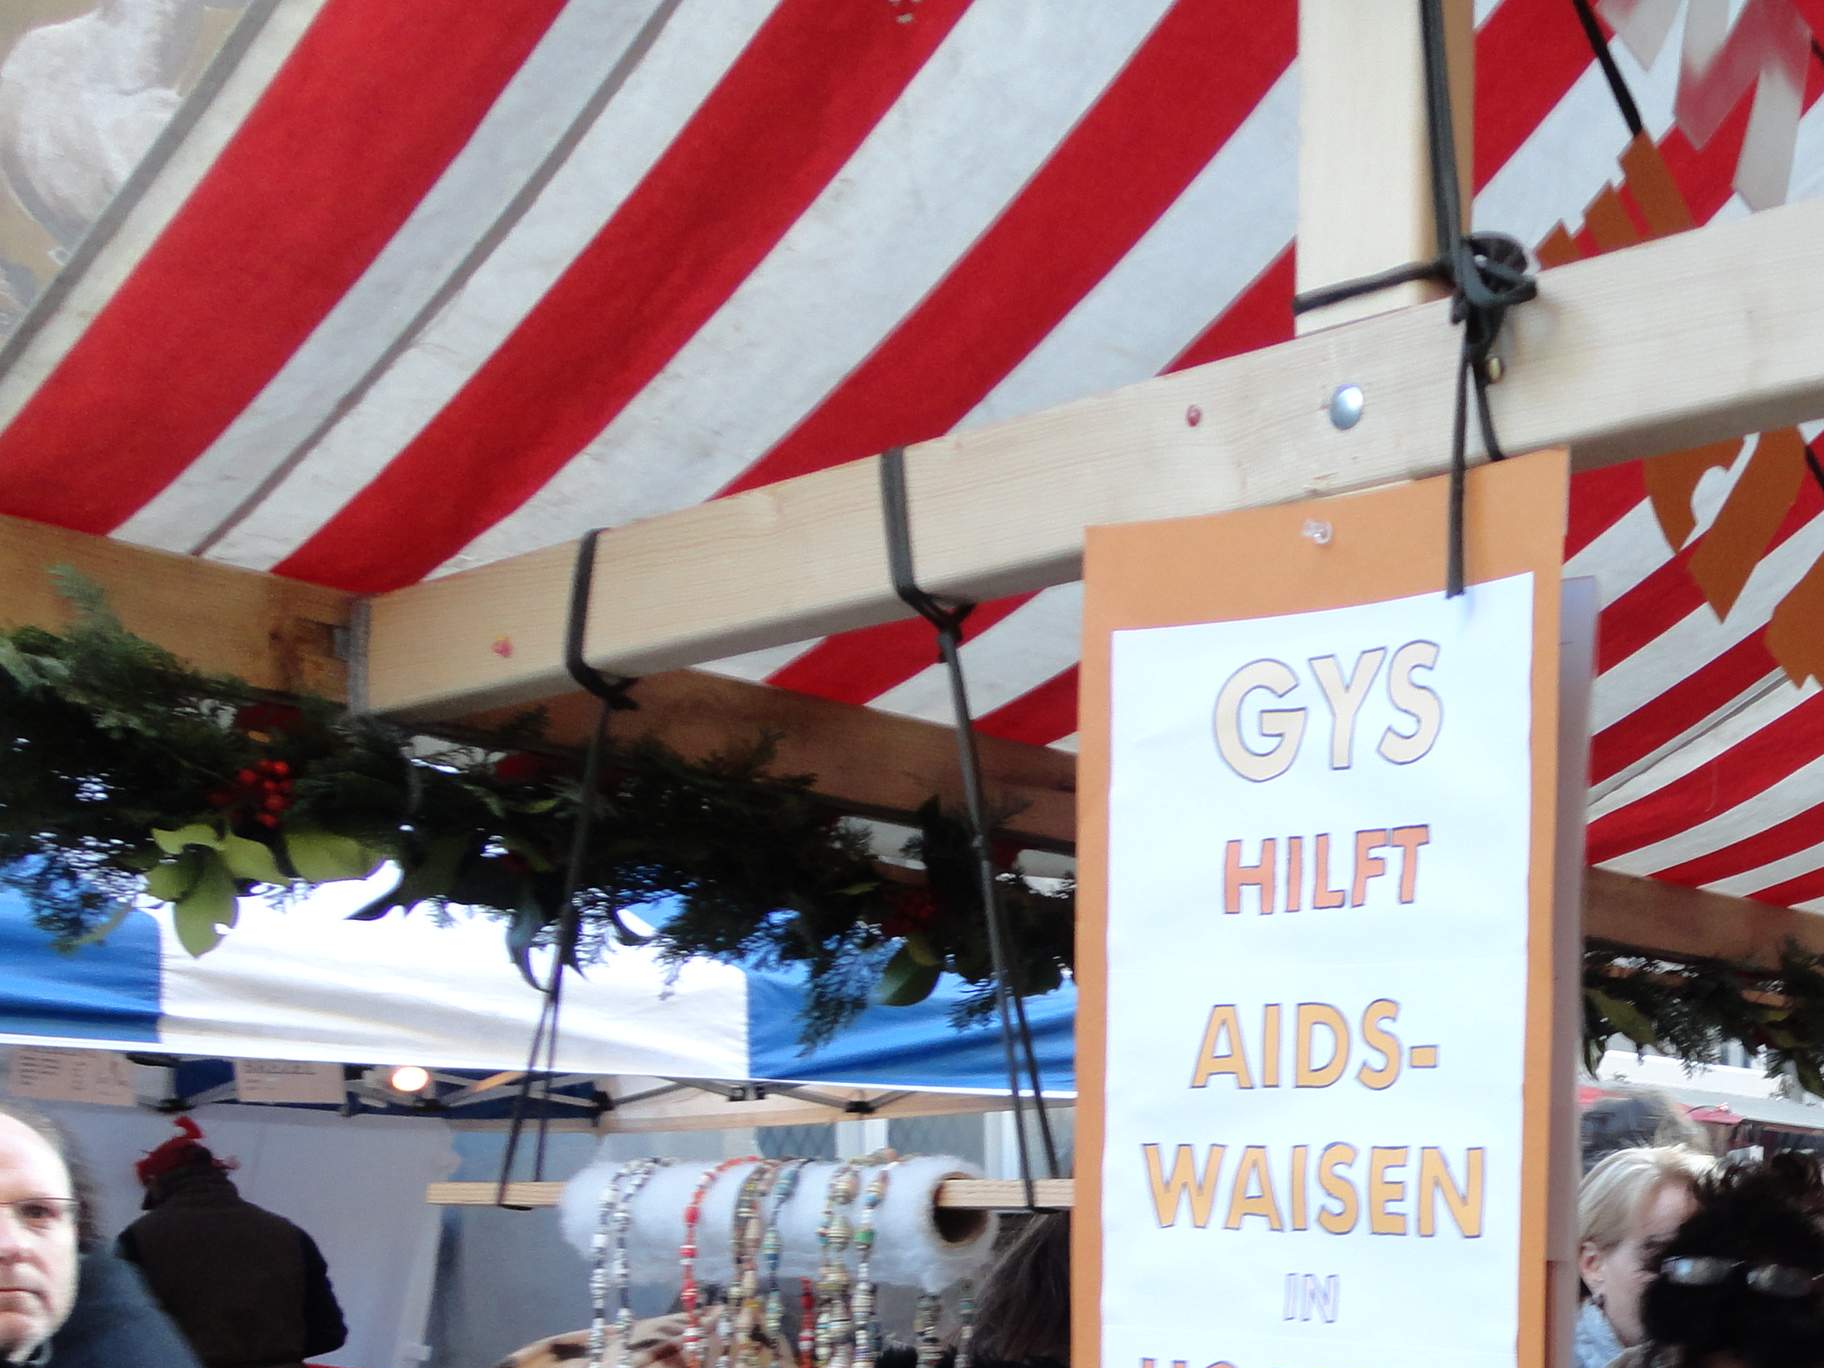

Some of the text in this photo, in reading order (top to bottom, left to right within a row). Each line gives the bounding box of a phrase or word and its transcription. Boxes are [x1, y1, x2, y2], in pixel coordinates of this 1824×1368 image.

[1213, 638, 1444, 783] GYS
[1223, 824, 1430, 916] HILFT
[1190, 998, 1440, 1091] AIDS-
[1140, 1141, 1487, 1239] WAISEN
[1282, 1272, 1341, 1324] IN
